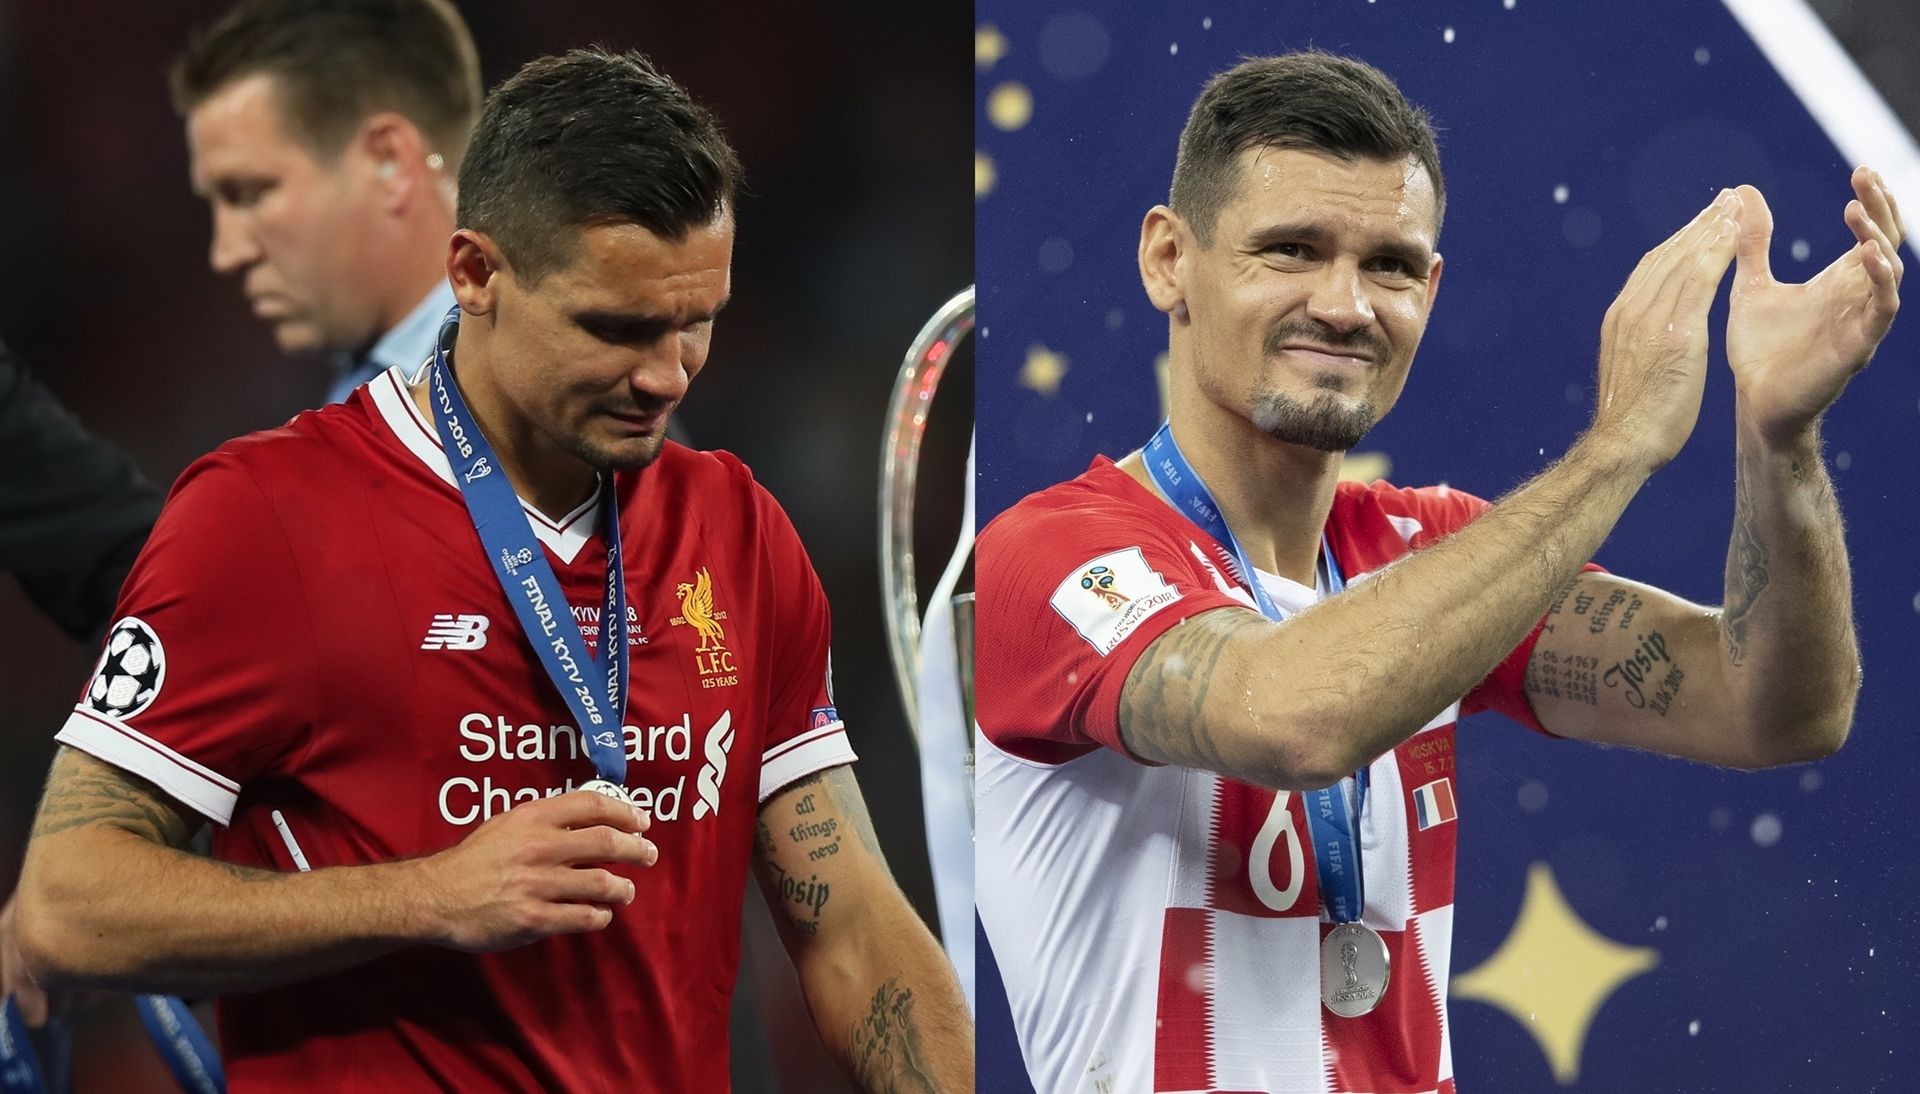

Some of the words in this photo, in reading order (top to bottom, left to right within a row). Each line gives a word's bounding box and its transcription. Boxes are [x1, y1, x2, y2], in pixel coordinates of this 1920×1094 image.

[447, 415, 473, 459] 2018
[1161, 457, 1182, 487] FIFA
[569, 606, 601, 622] KYIV
[1106, 605, 1147, 652] RUSSIA
[521, 575, 554, 637] FINAL
[551, 637, 583, 683] KYIV
[575, 685, 603, 726] 2018
[695, 651, 738, 675] L.F.C.
[607, 660, 619, 710] INAL
[702, 678, 716, 689] 125
[715, 675, 739, 688] YEARS
[1603, 630, 1671, 710] Josip
[789, 818, 838, 843] things
[1248, 790, 1305, 912] 6
[1327, 840, 1344, 874] FIFA
[1334, 895, 1349, 919] FIF
